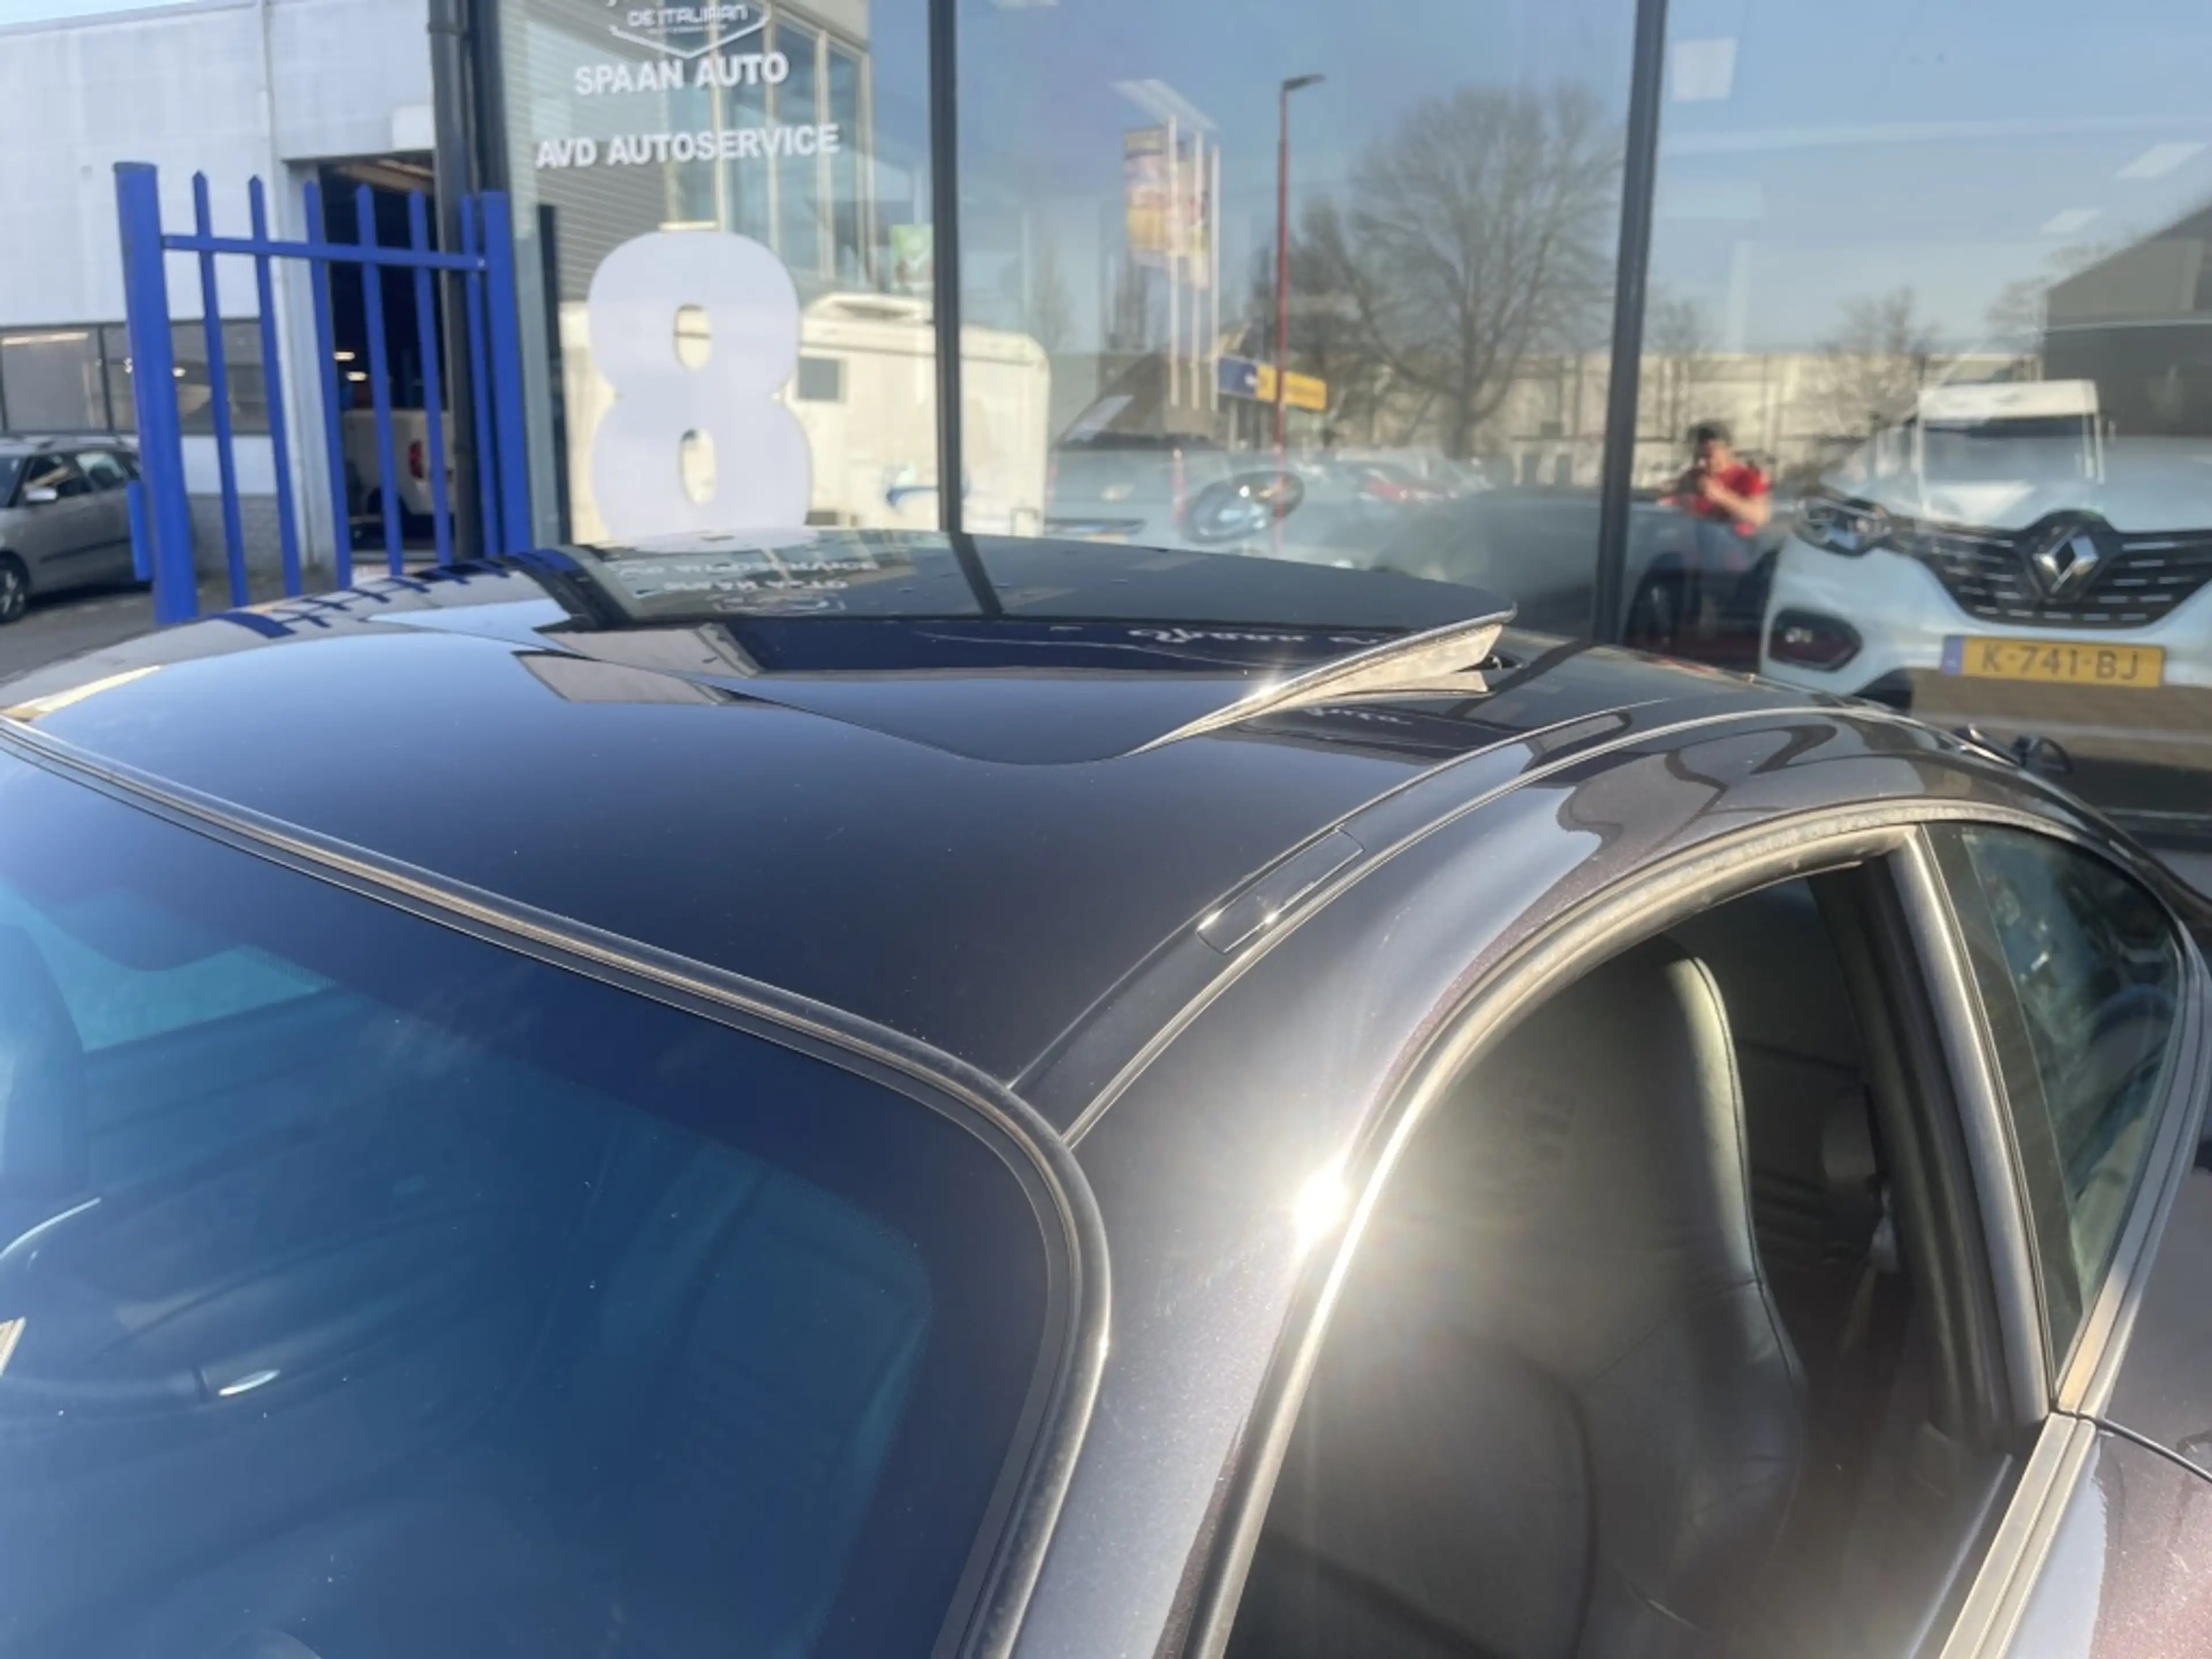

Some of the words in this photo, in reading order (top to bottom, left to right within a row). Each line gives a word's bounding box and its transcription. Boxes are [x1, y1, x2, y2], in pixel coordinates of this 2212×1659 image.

[575, 59, 684, 96] SPAAN
[695, 52, 790, 89] AUTO
[536, 138, 597, 169] AVD
[607, 123, 840, 166] AUTOSERVICE
[587, 230, 813, 537] 8
[1982, 642, 2138, 681] K-741-BJ
